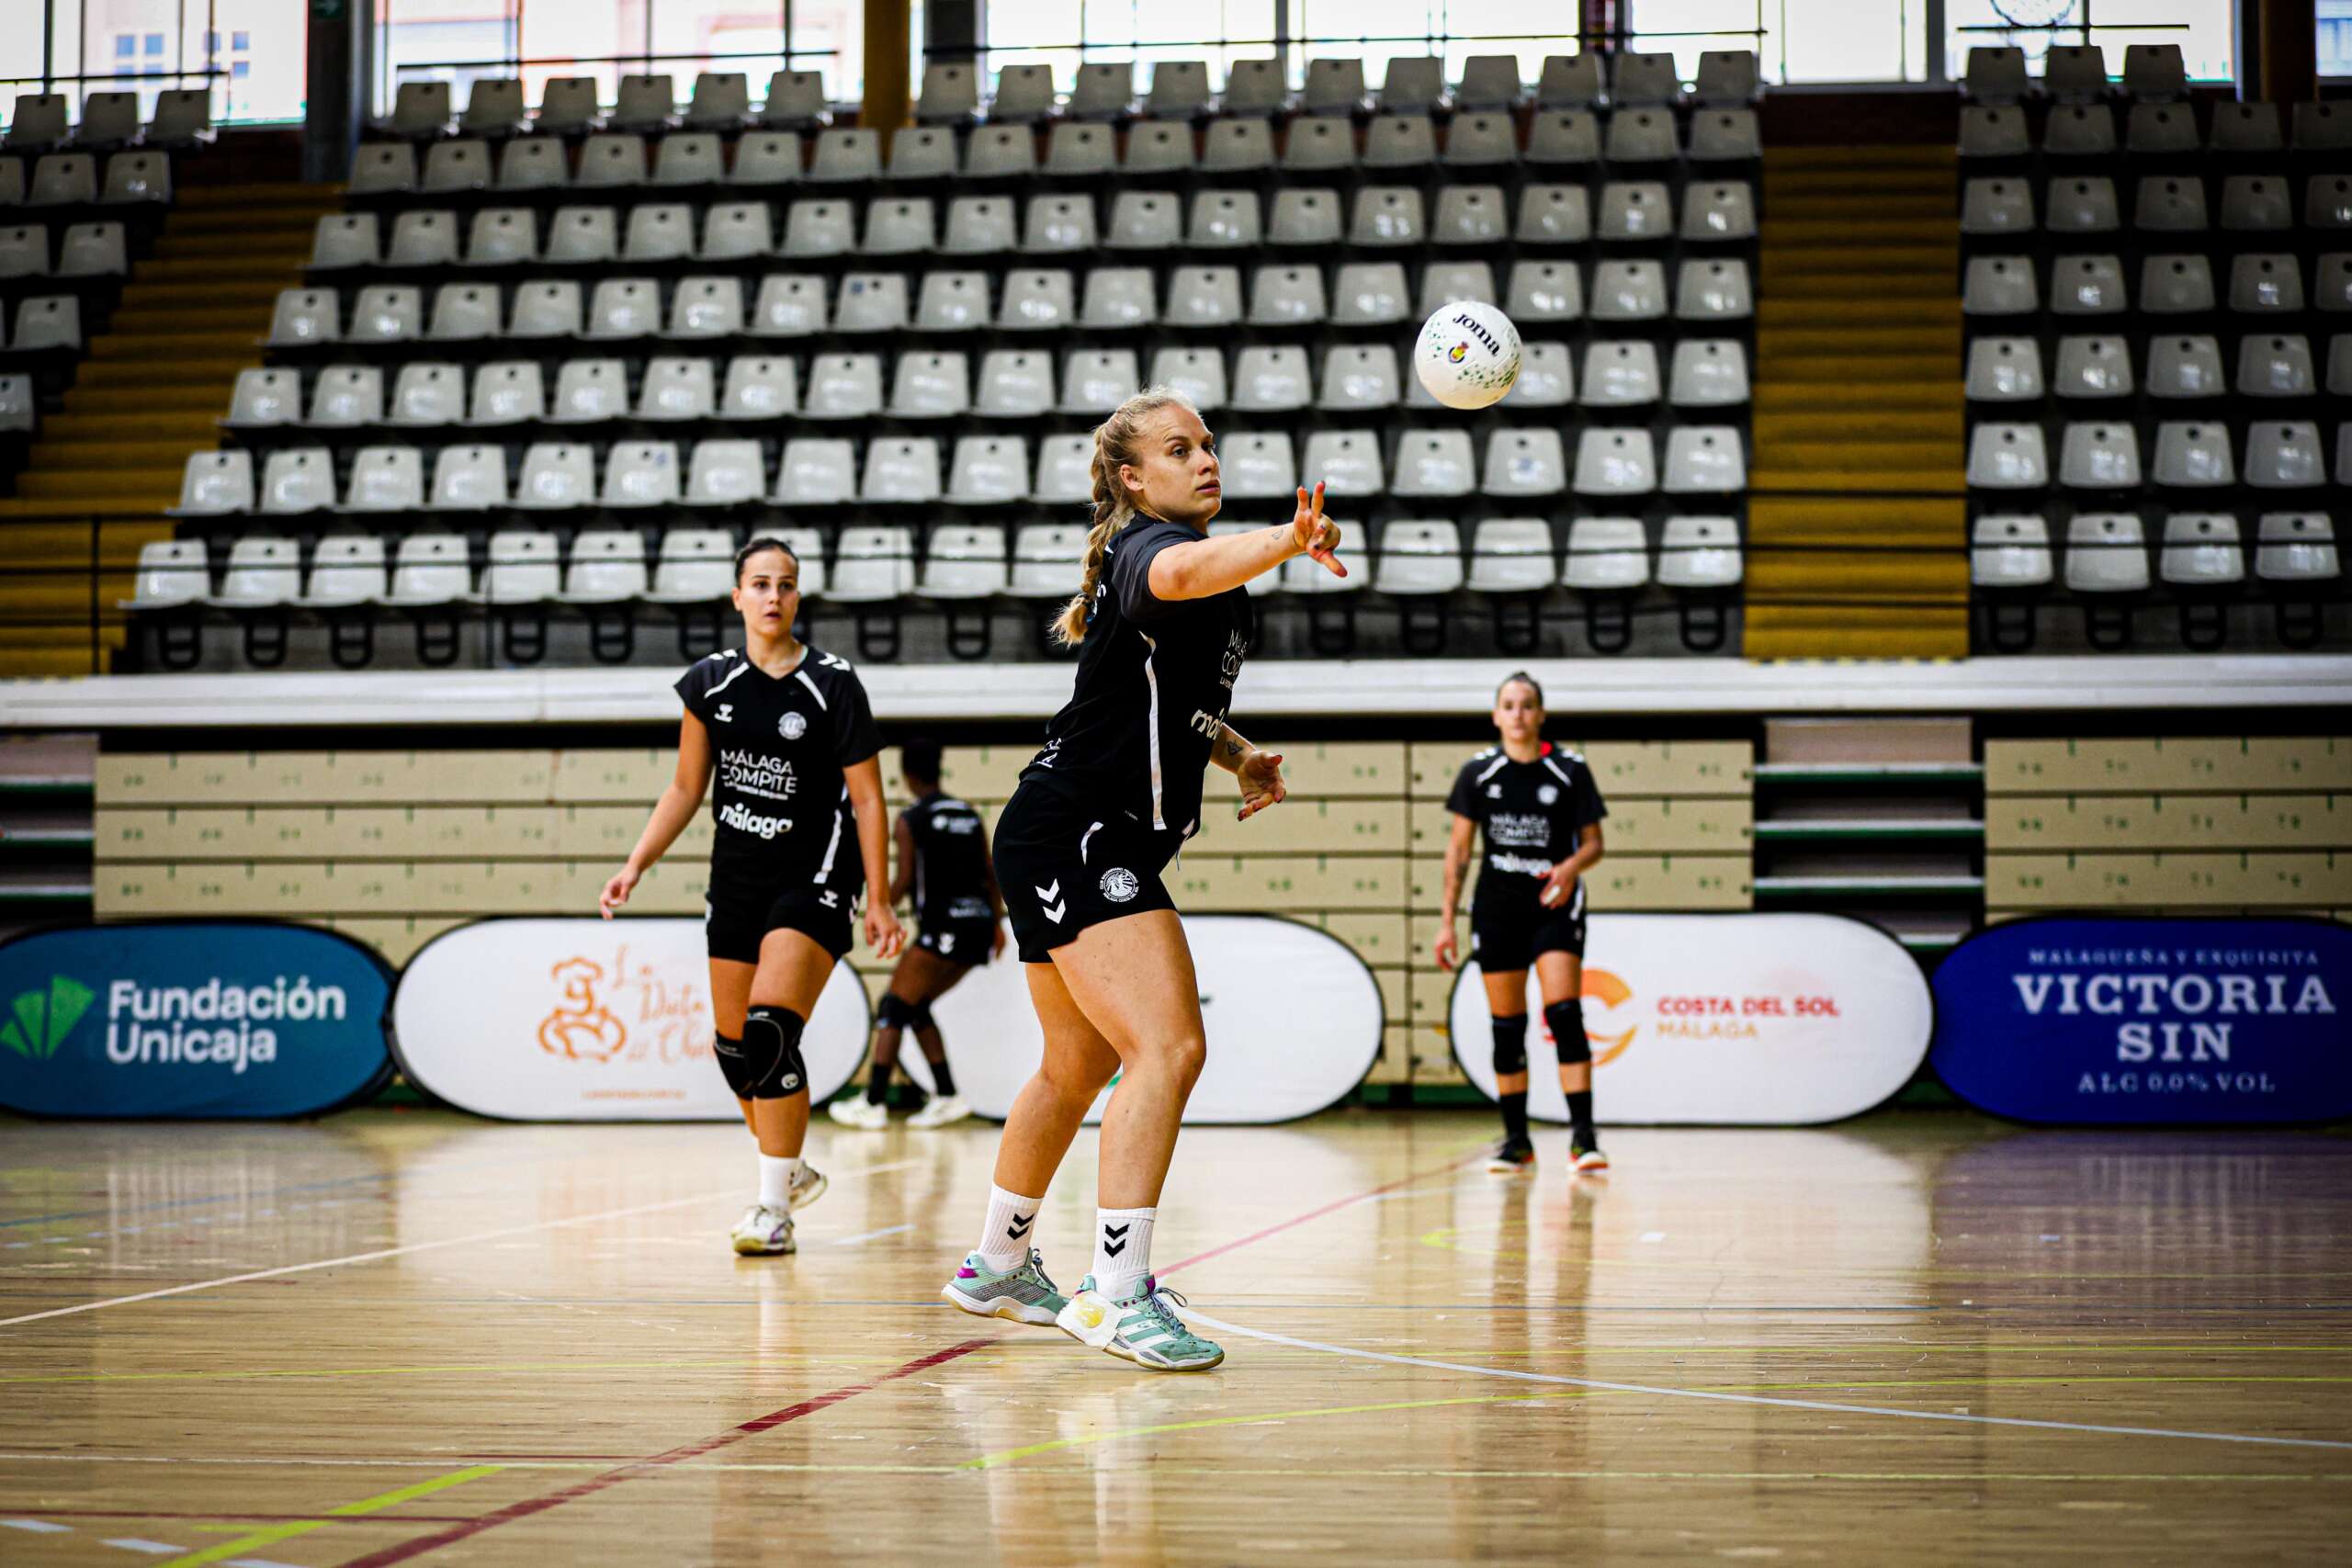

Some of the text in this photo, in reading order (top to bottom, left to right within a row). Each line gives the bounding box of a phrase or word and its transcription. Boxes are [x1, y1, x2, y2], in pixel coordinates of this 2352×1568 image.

[720, 749, 793, 775] MÁLAGA
[2029, 948, 2319, 968] MALAGUEÑA Y EXQUISITA
[107, 976, 346, 1021] Fundación
[1657, 997, 1841, 1017] COSTA DEL SOL
[2013, 974, 2336, 1015] VICTORIA
[1657, 1018, 1758, 1039] MÁLAGA
[2117, 1021, 2233, 1062] SIN
[106, 1021, 277, 1074] Unicaja
[2077, 1072, 2139, 1093] ALC
[2216, 1072, 2276, 1093] VOL
